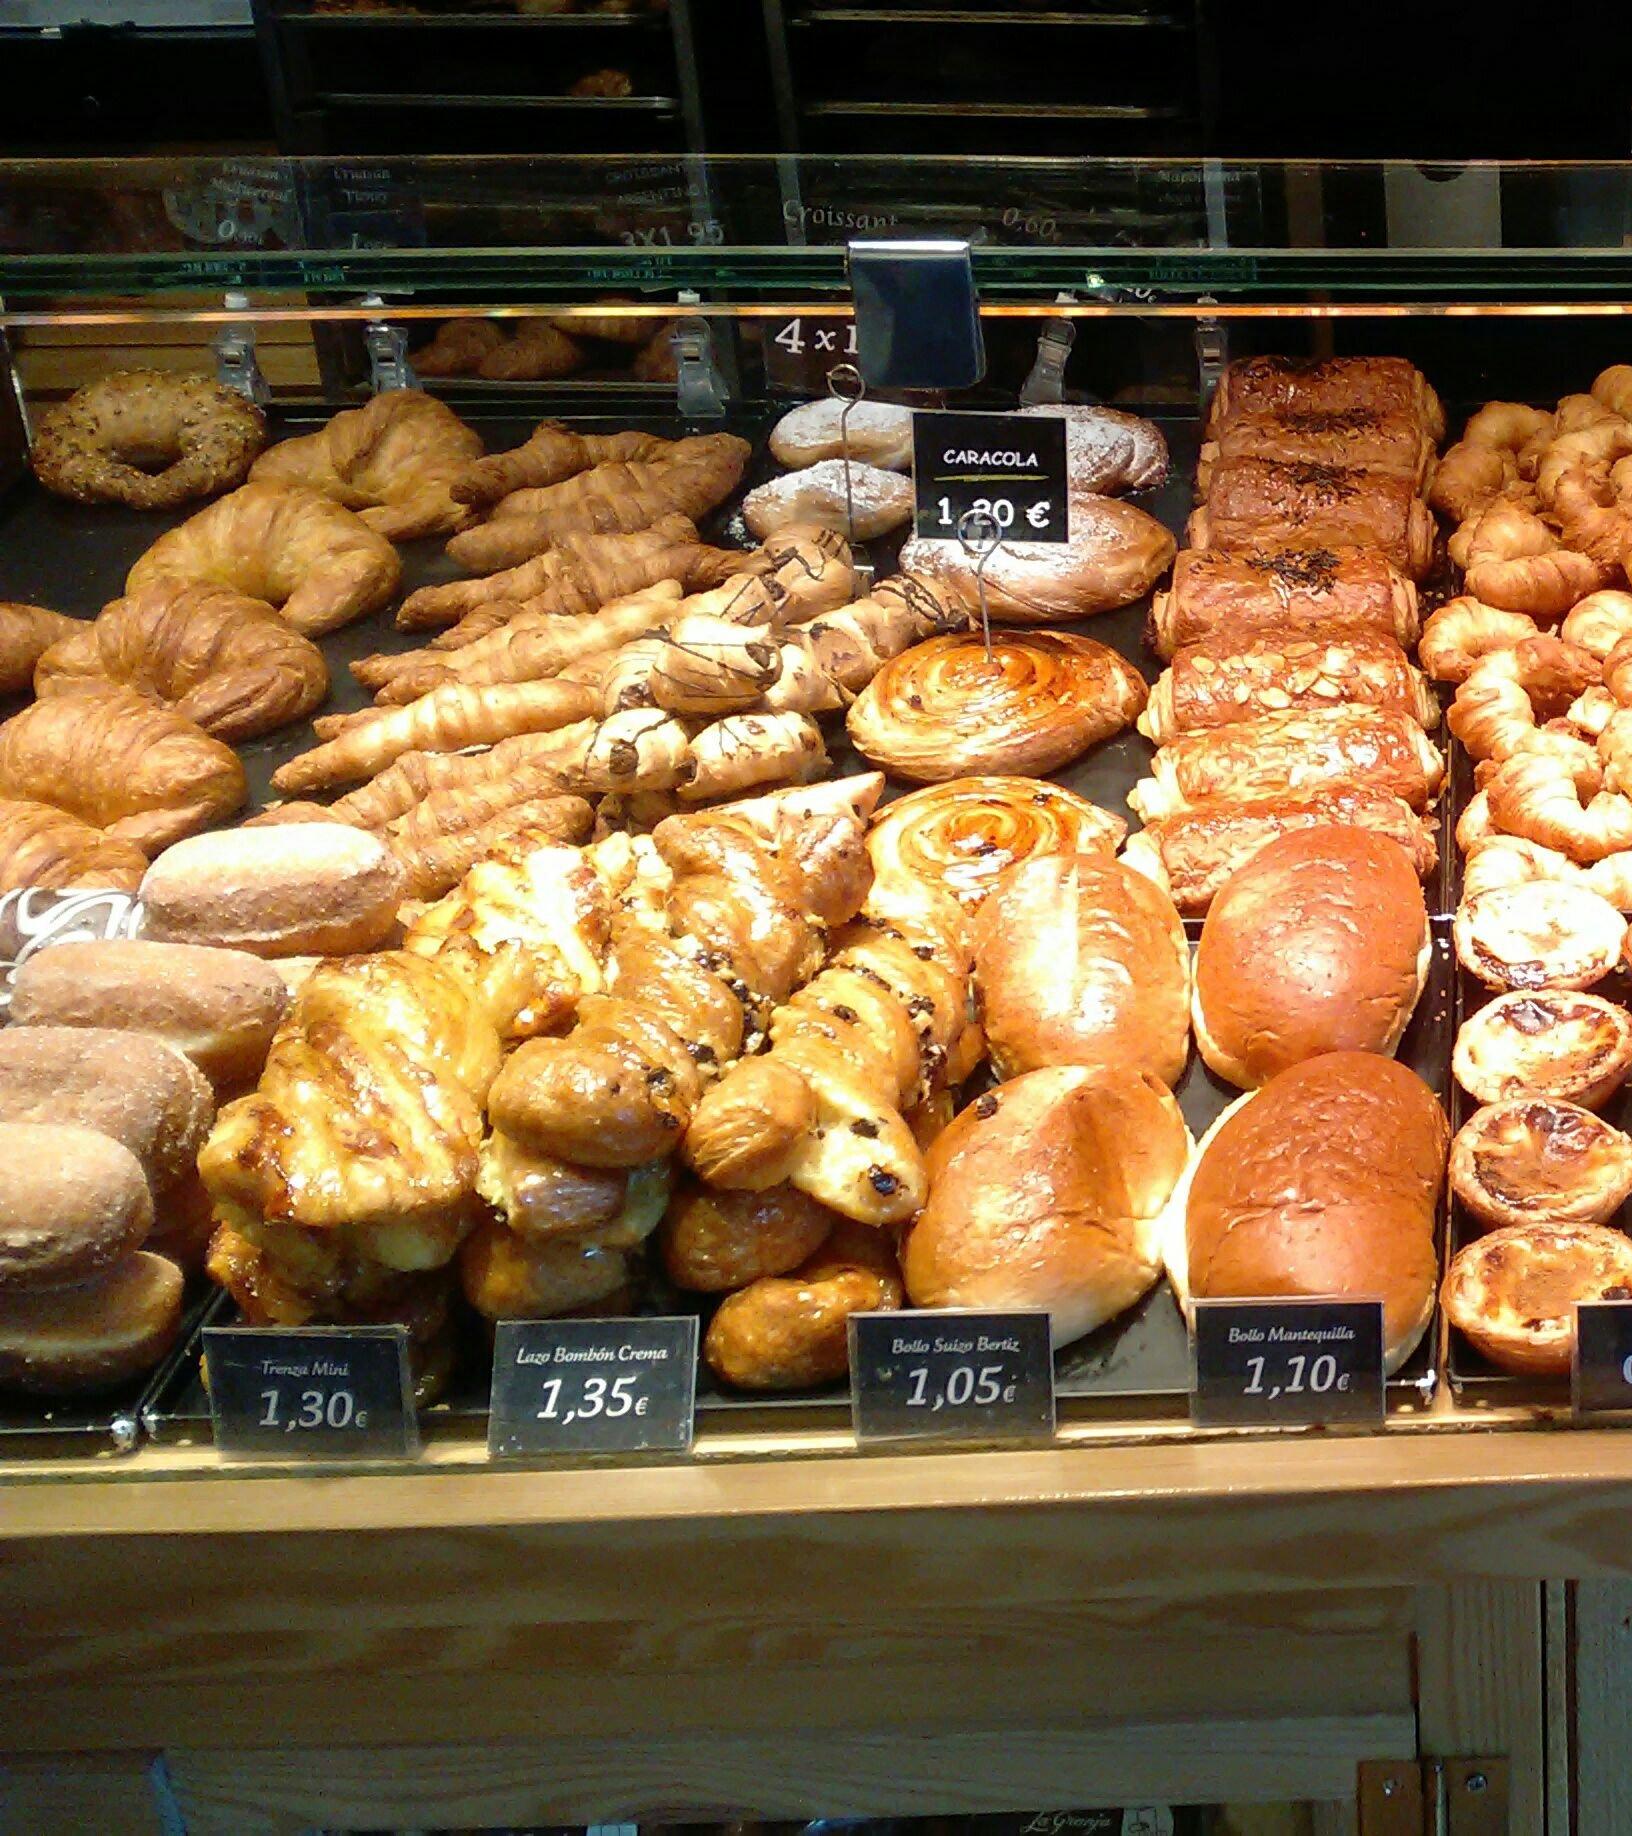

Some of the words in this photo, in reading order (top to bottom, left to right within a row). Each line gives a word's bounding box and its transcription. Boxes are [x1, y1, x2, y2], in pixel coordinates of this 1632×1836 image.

[782, 199, 898, 233] Croissant
[942, 449, 1039, 467] CARACOLA
[1025, 501, 1051, 528] €
[892, 1337, 931, 1354] Bollo
[933, 1337, 974, 1354] Suizo
[976, 1335, 1021, 1353] Bertiz
[1228, 1326, 1265, 1343] Bollo
[1267, 1325, 1356, 1344] Mantequilla
[516, 1347, 551, 1365] Lazo
[553, 1345, 616, 1363] Bombón
[618, 1344, 668, 1361] Crema
[261, 1359, 309, 1378] Trenza
[311, 1359, 349, 1377] Mini
[1243, 1354, 1351, 1400] 1,10€
[536, 1376, 650, 1425] 1,35€
[906, 1365, 1017, 1411] 1,05€
[259, 1389, 368, 1432] 1,30€
